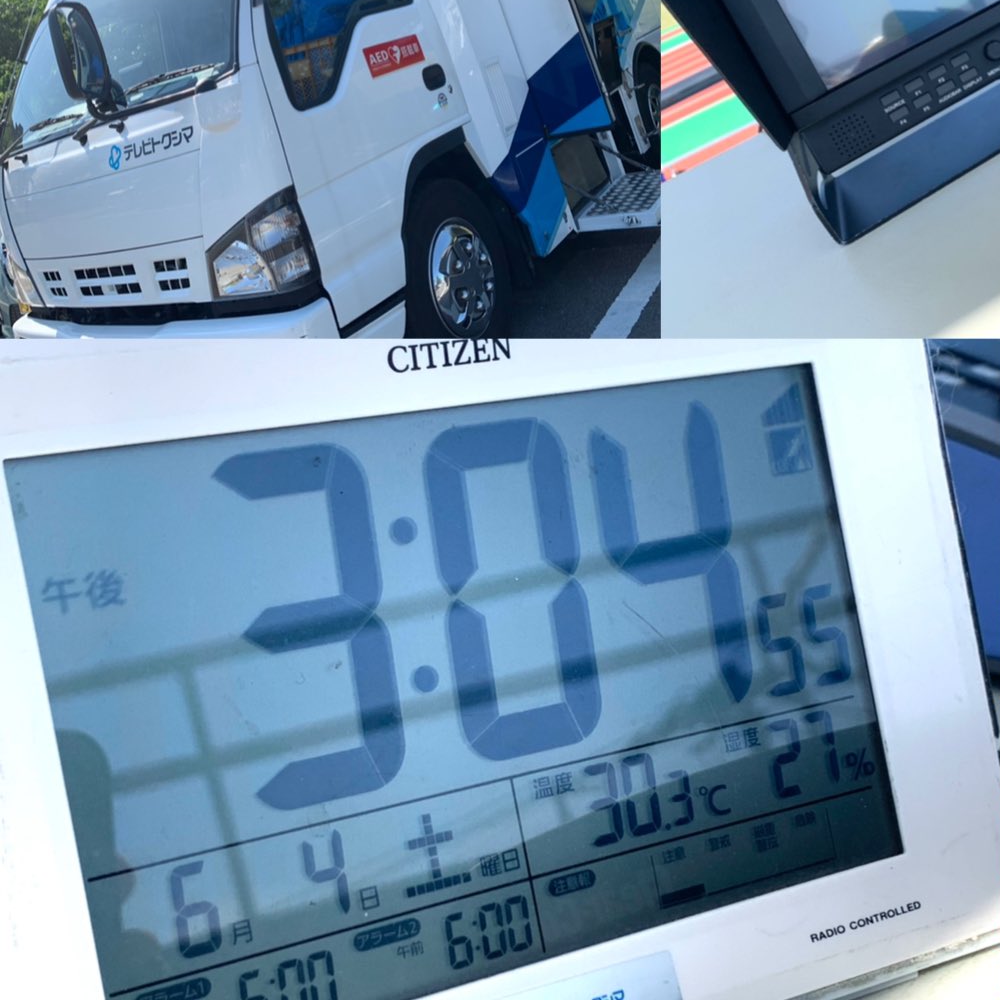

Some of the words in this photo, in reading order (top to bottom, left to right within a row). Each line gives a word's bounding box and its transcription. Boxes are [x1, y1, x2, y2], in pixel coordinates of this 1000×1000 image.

[369, 50, 389, 65] AED
[124, 125, 194, 161] テレビトクシマ
[387, 338, 511, 373] CITIZEN
[42, 569, 127, 615] 午後
[211, 400, 754, 812] 3:04
[757, 583, 851, 697] 55
[723, 727, 760, 753] 湿度
[533, 772, 575, 799] 温度
[356, 921, 418, 950] アラーム2
[397, 942, 424, 959] 午前
[445, 895, 533, 970] 6:00
[810, 924, 846, 943] RADIO
[849, 900, 922, 930] CONTROLLED
